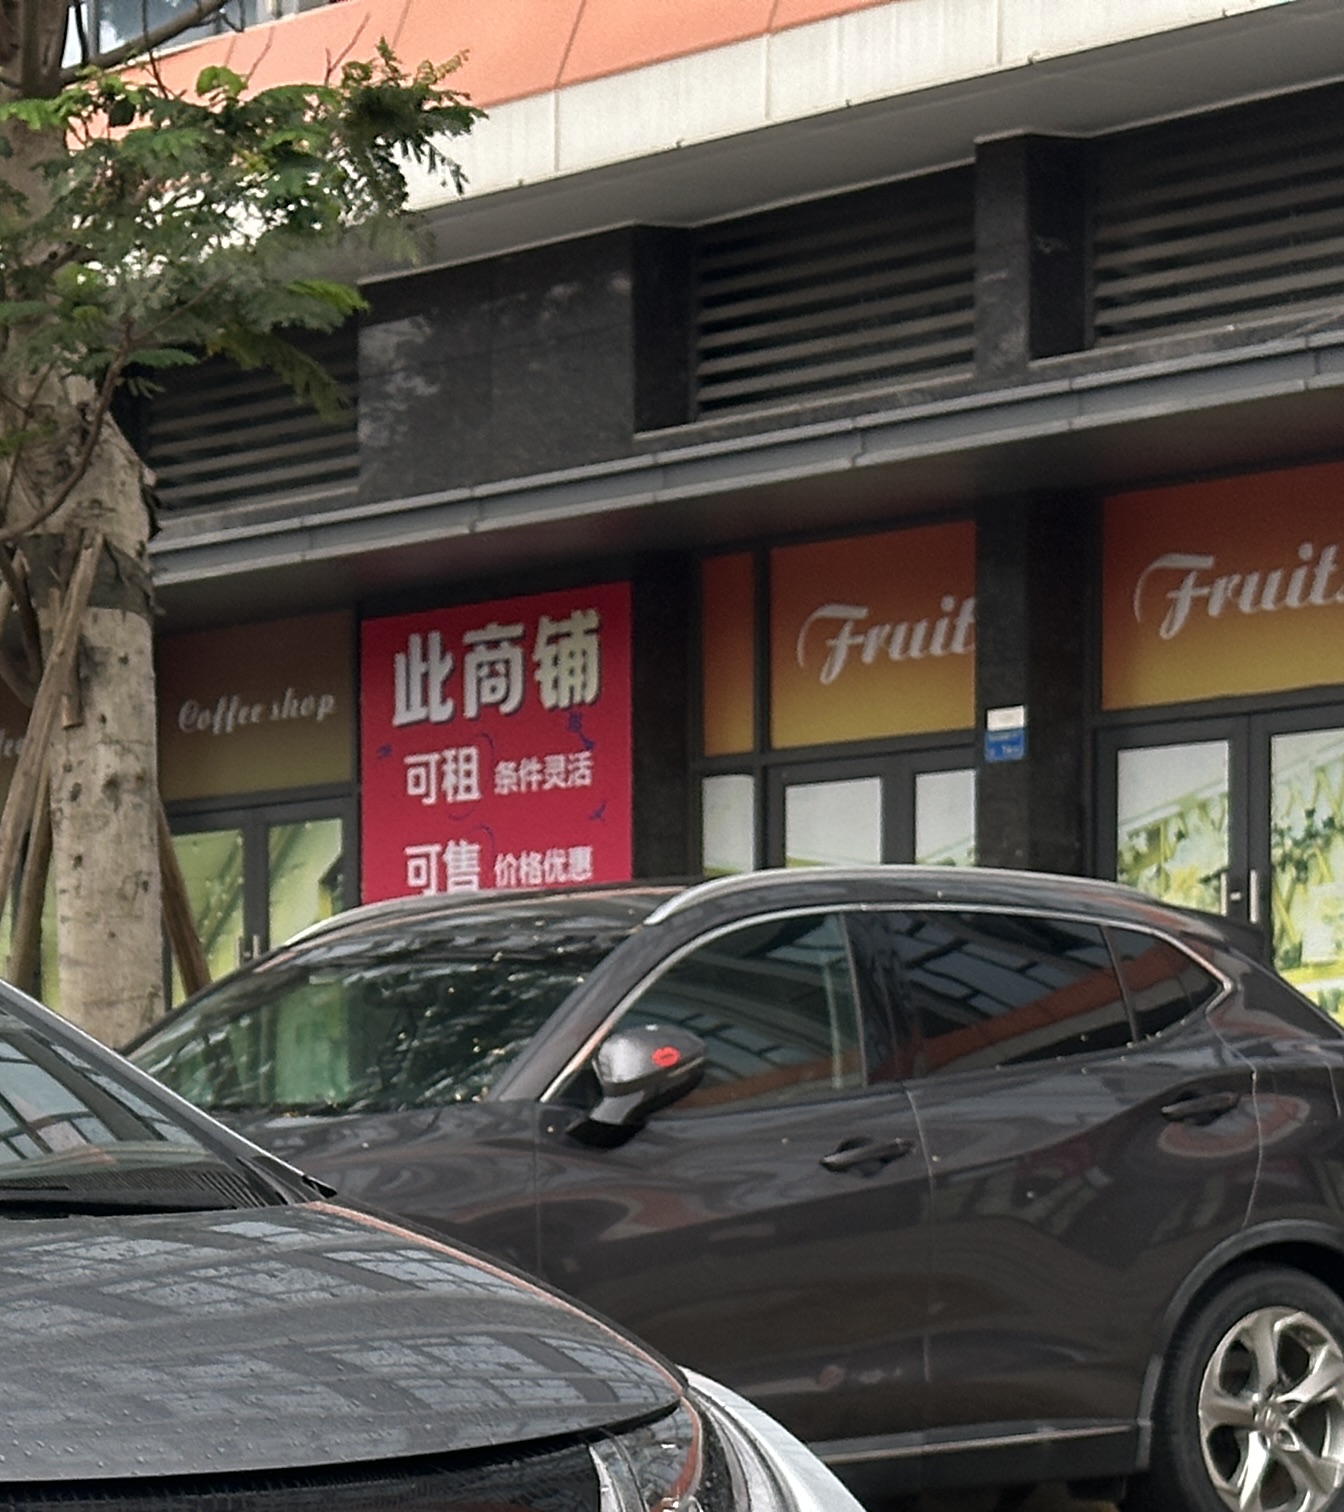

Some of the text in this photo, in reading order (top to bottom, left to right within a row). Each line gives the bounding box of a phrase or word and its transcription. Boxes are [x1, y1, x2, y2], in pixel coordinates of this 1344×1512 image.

[1133, 542, 1344, 640] Fruit
[392, 608, 600, 727] 此商铺
[178, 687, 335, 735] Coffee shop
[403, 746, 593, 805] 可租 条件灵活
[403, 839, 593, 896] 可售 价格优惠
